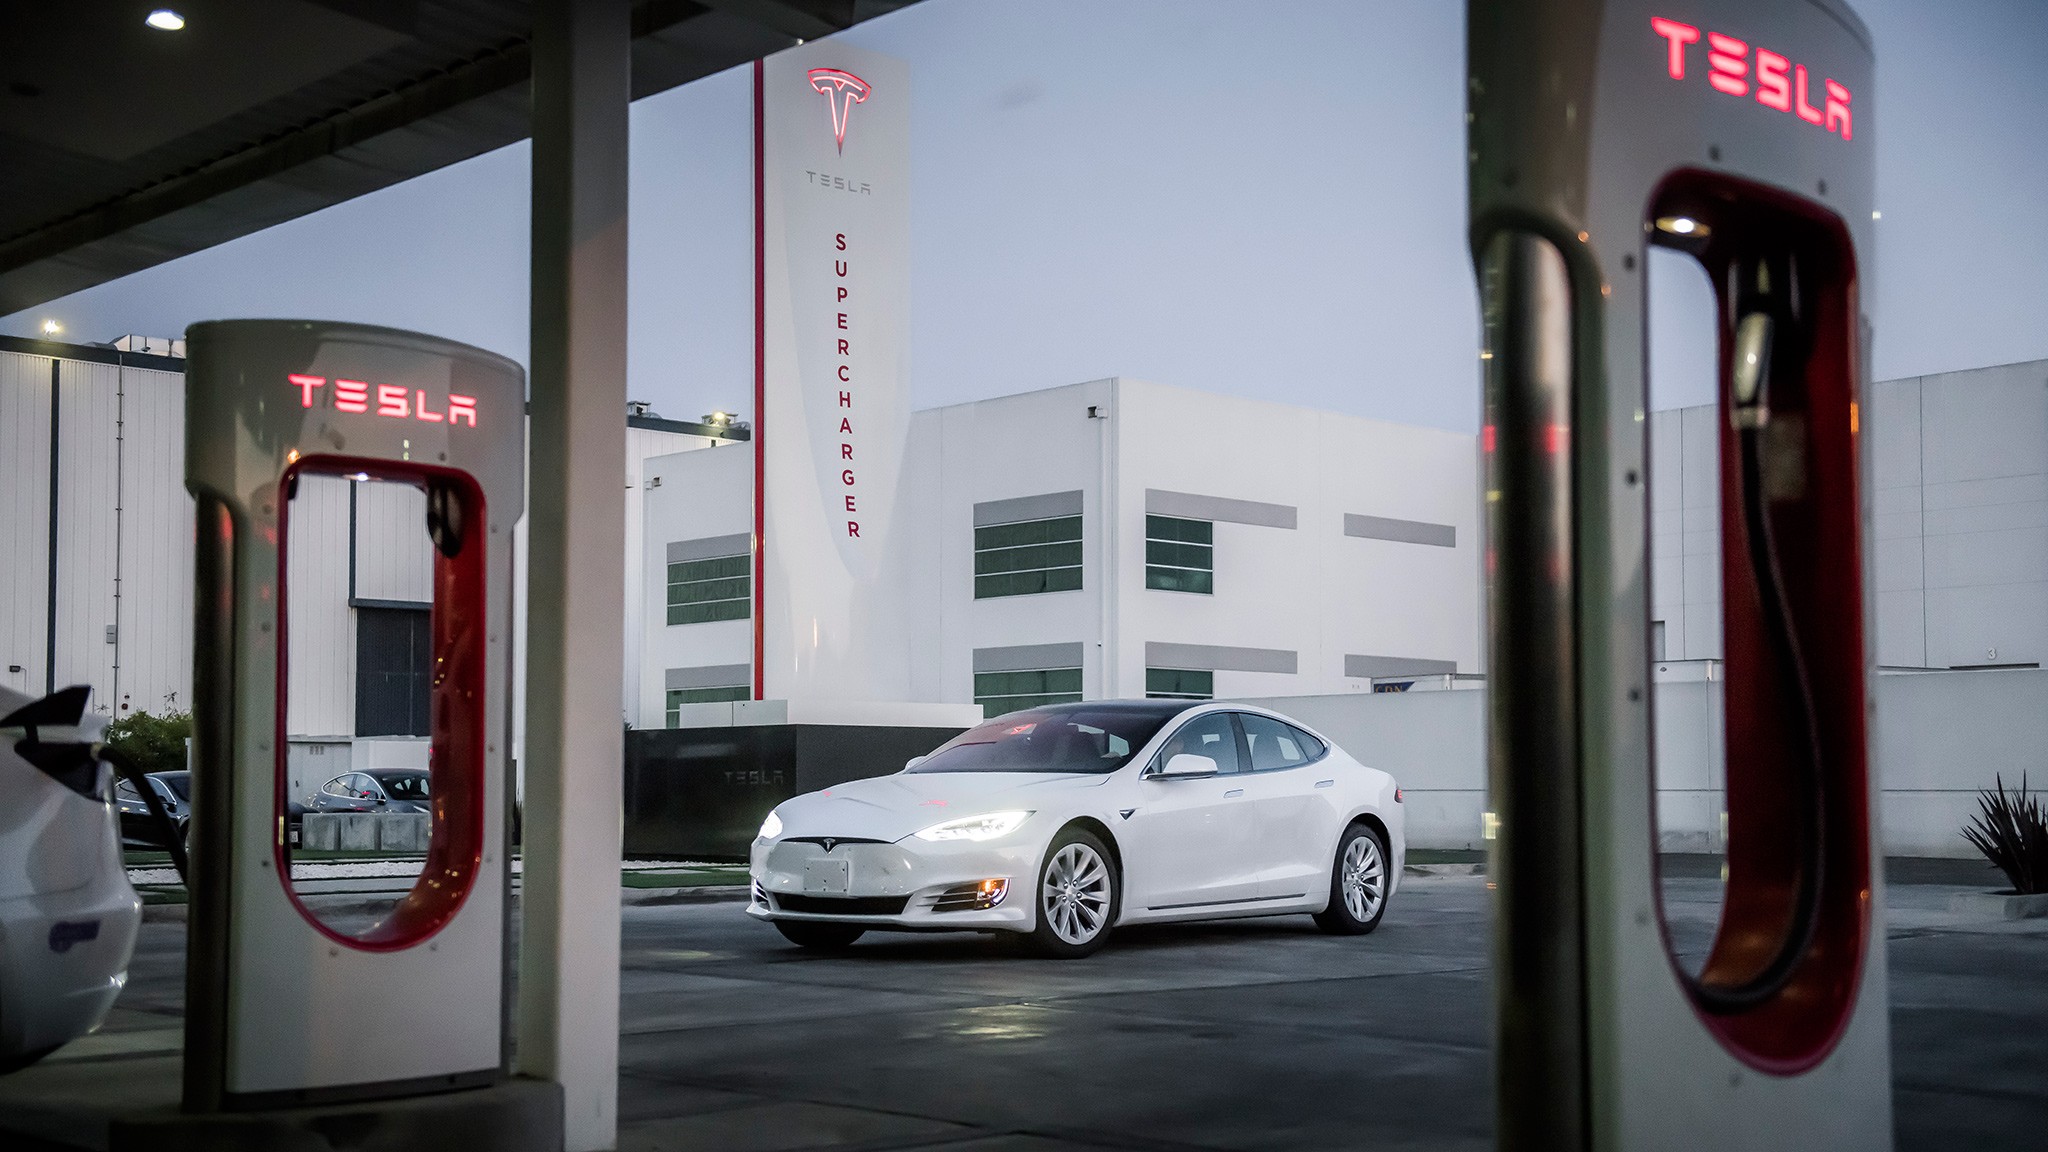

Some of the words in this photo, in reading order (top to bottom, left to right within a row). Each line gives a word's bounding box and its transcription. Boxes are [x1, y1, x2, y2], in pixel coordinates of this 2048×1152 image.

[1651, 16, 1852, 141] TESLA
[805, 170, 871, 196] TESLA
[288, 373, 477, 428] TESLA
[835, 233, 860, 538] SUPERCHARGER
[1987, 647, 1997, 660] 3
[724, 770, 784, 785] TESLA
